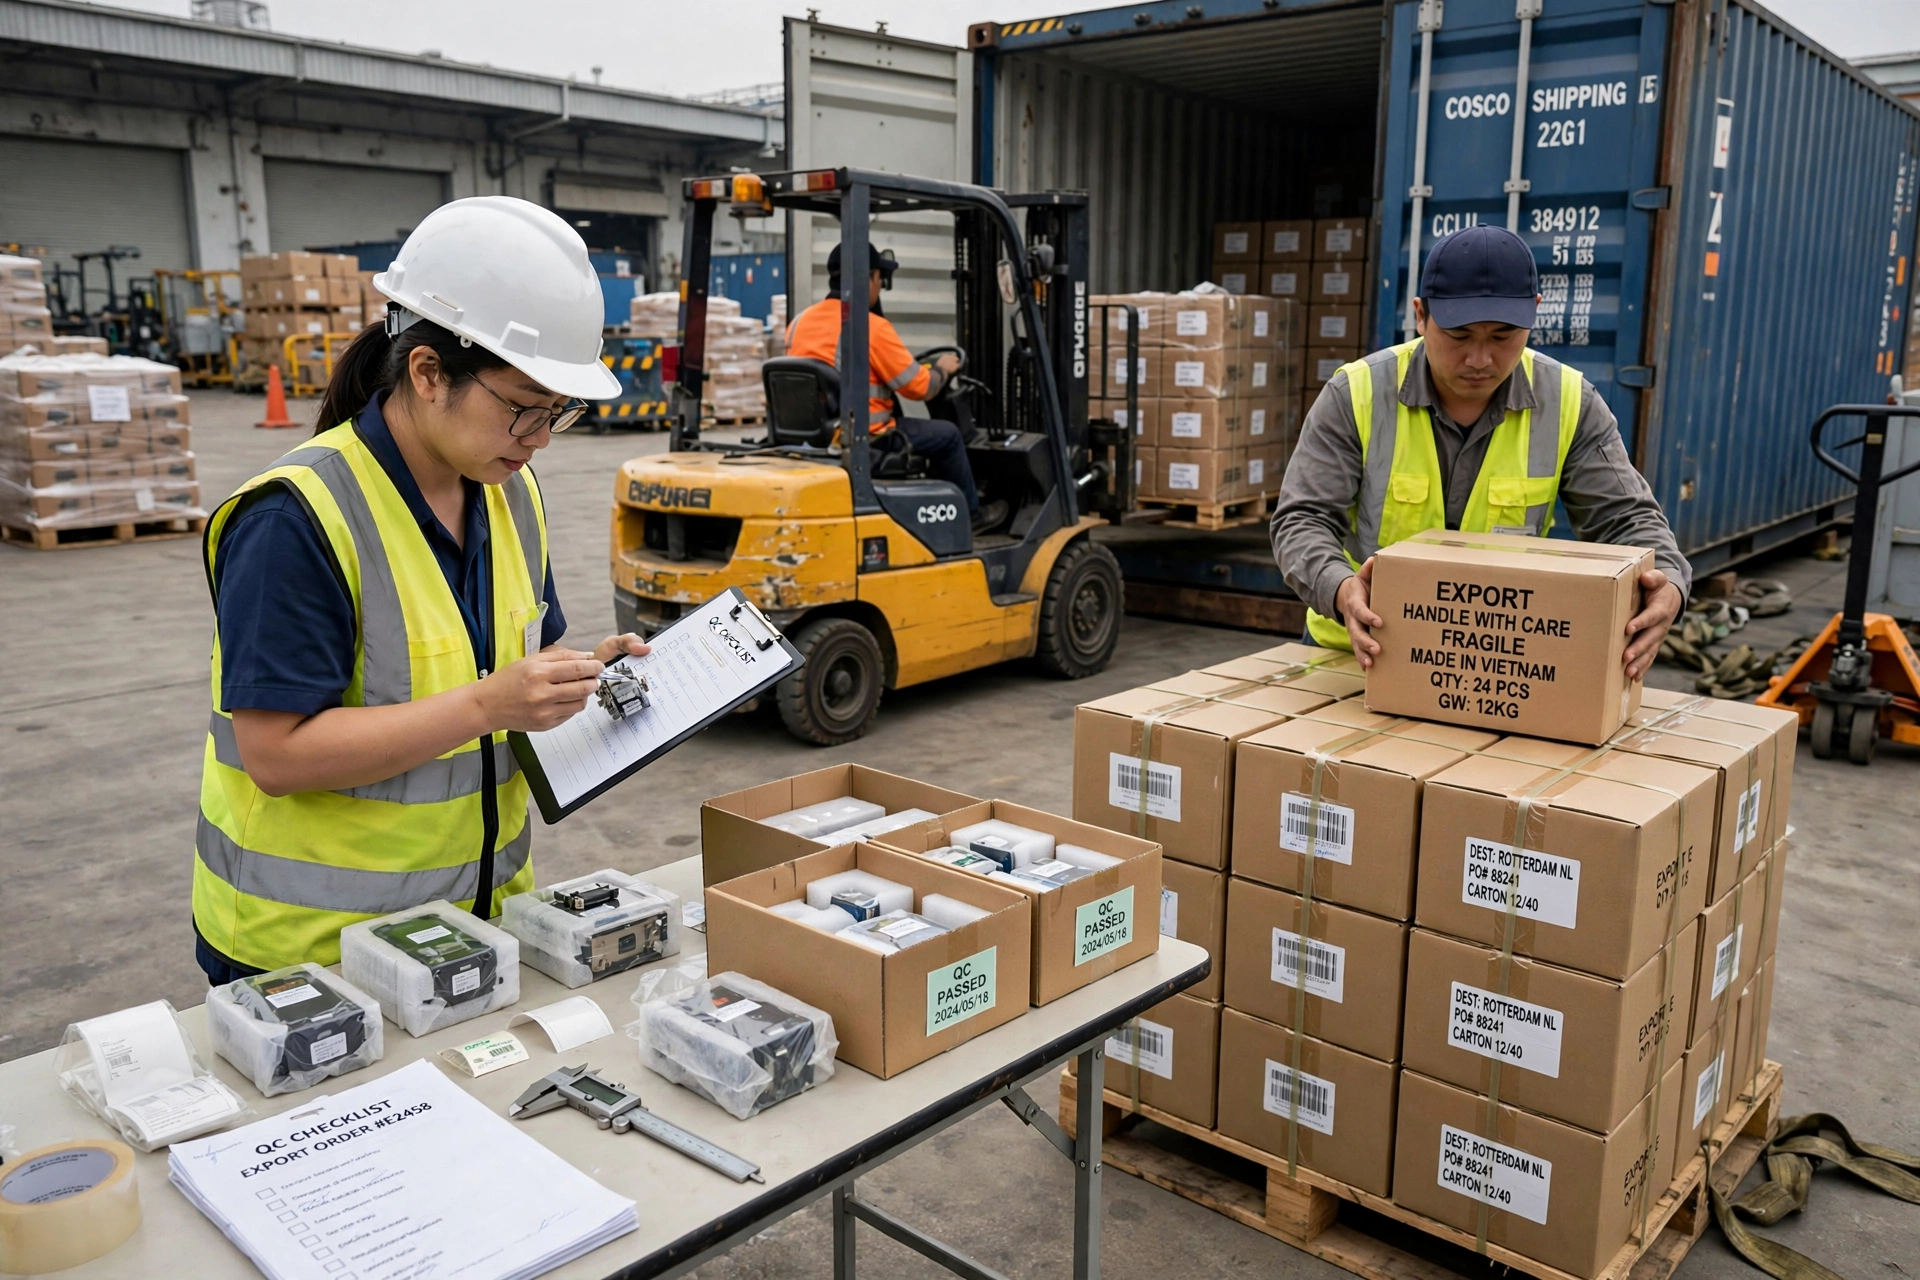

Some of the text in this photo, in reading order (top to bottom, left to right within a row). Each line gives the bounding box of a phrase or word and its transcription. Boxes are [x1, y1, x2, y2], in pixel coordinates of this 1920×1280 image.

[1445, 92, 1510, 120] COSCO
[1532, 81, 1627, 113] SHIPPING
[1537, 119, 1586, 148] 22G1
[1530, 206, 1600, 232] 384912
[918, 504, 957, 524] CSCO
[1437, 581, 1533, 610] EXPORT
[1403, 603, 1570, 638] HANDLE WITH CARE
[1441, 629, 1525, 656] FRAGILE
[1410, 648, 1555, 681] MADE IN VIETNAM
[1473, 677, 1491, 694] 24
[1496, 680, 1530, 700] PCS
[1438, 693, 1518, 718] GW: 12KG
[1469, 864, 1519, 888] PO# 88241
[1470, 844, 1573, 880] DEST: ROTTERDAM NL
[1098, 900, 1114, 916] QC
[1468, 883, 1539, 912] CARTON 12/40
[1084, 911, 1125, 938] PASSED
[1082, 927, 1127, 956] 2024/05/18
[953, 962, 972, 980] QC
[938, 974, 986, 1005] PASSED
[935, 991, 989, 1025] 2024/05/18
[1454, 1007, 1504, 1034] PO# 88241
[1456, 989, 1556, 1031] DEST: ROTTERDAM NL
[1453, 1026, 1523, 1059] CARTON 12/40
[240, 1147, 310, 1178] EXPORT
[314, 1125, 373, 1150] ORDER
[374, 1102, 432, 1128] #E2458
[255, 1139, 288, 1154] QC
[290, 1100, 392, 1142] CHECKLIST
[1444, 1149, 1493, 1179] PO# 88241
[1445, 1131, 1544, 1180] DEST: ROTTERDAM NL
[1442, 1168, 1511, 1204] CARTON 12/40
